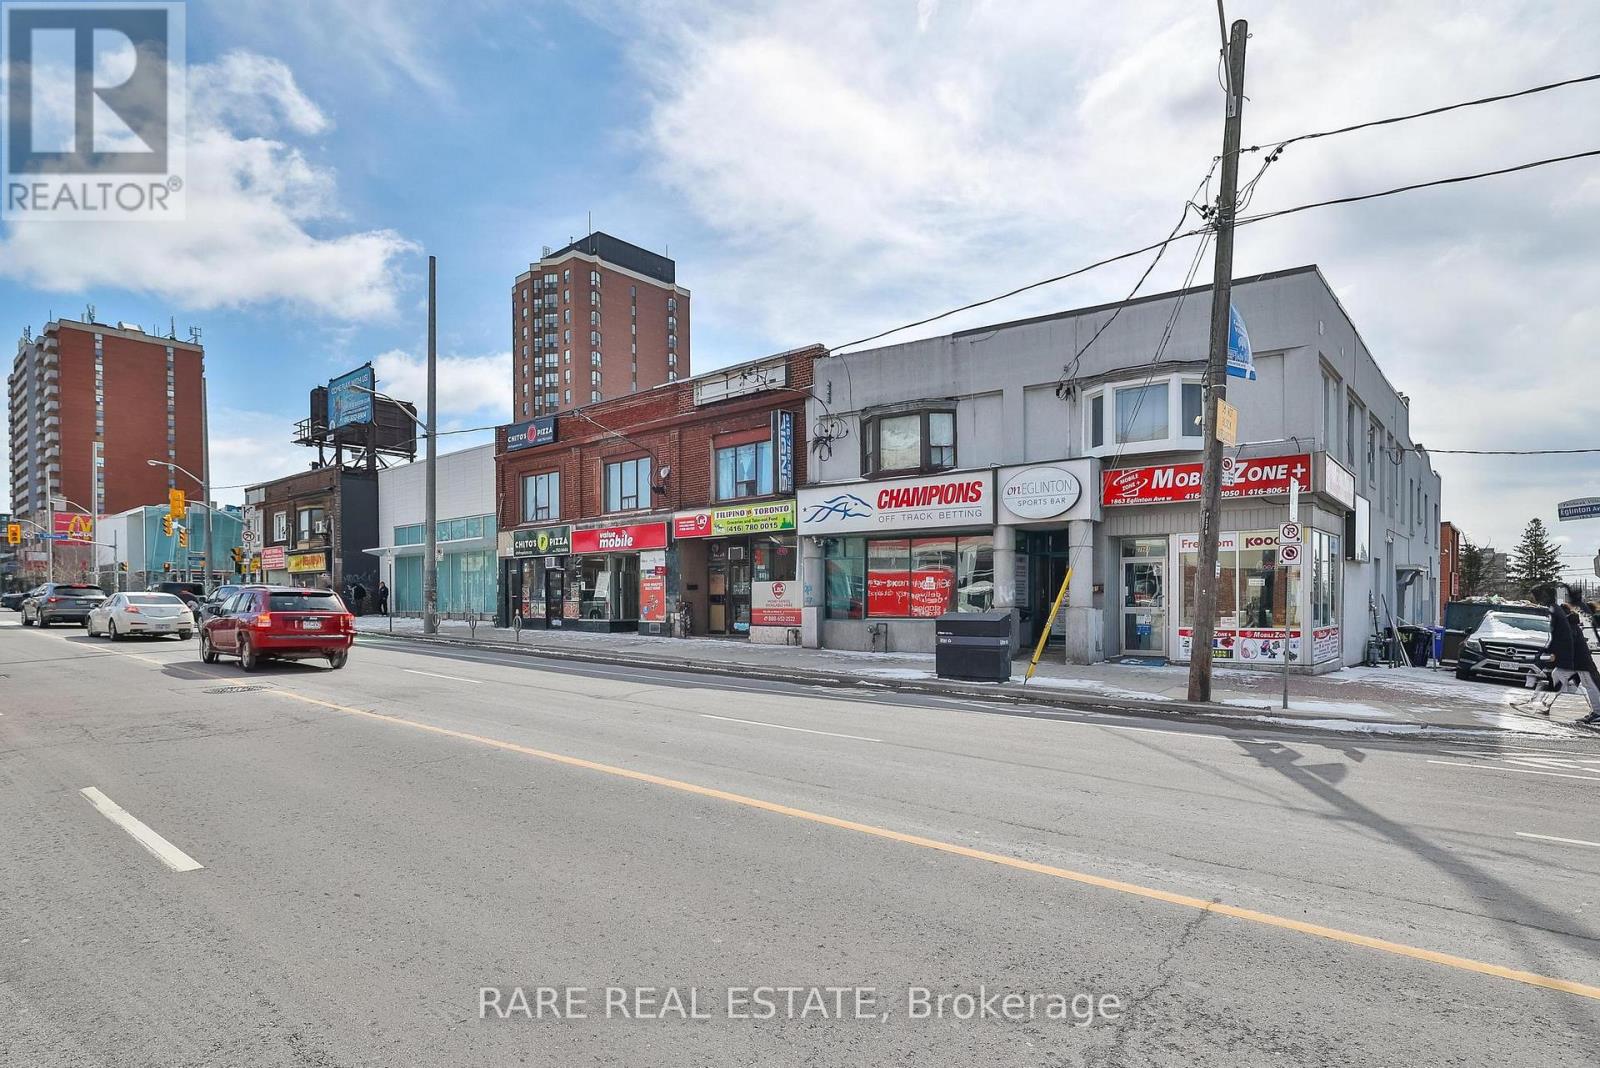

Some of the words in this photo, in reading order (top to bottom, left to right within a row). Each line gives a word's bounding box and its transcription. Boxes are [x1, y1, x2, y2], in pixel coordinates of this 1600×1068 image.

[536, 426, 553, 437] PIZZA
[1232, 462, 1289, 484] ZONE
[877, 480, 984, 510] CHAMPIONS
[1017, 498, 1048, 507] SPORTS
[1050, 497, 1066, 505] BAR
[753, 505, 790, 516] TORONTO
[1560, 506, 1591, 517] Eglinton
[878, 513, 896, 524] OFF
[902, 511, 933, 522] TRACK
[938, 509, 983, 520] BETTING
[726, 524, 744, 532] (416)
[745, 523, 759, 531] 780
[760, 522, 778, 530] 0015
[599, 530, 616, 539] value
[514, 539, 537, 549] CHITO'S
[549, 537, 569, 546] PIZZA
[599, 534, 634, 548] mobile
[1181, 539, 1234, 549] Freom
